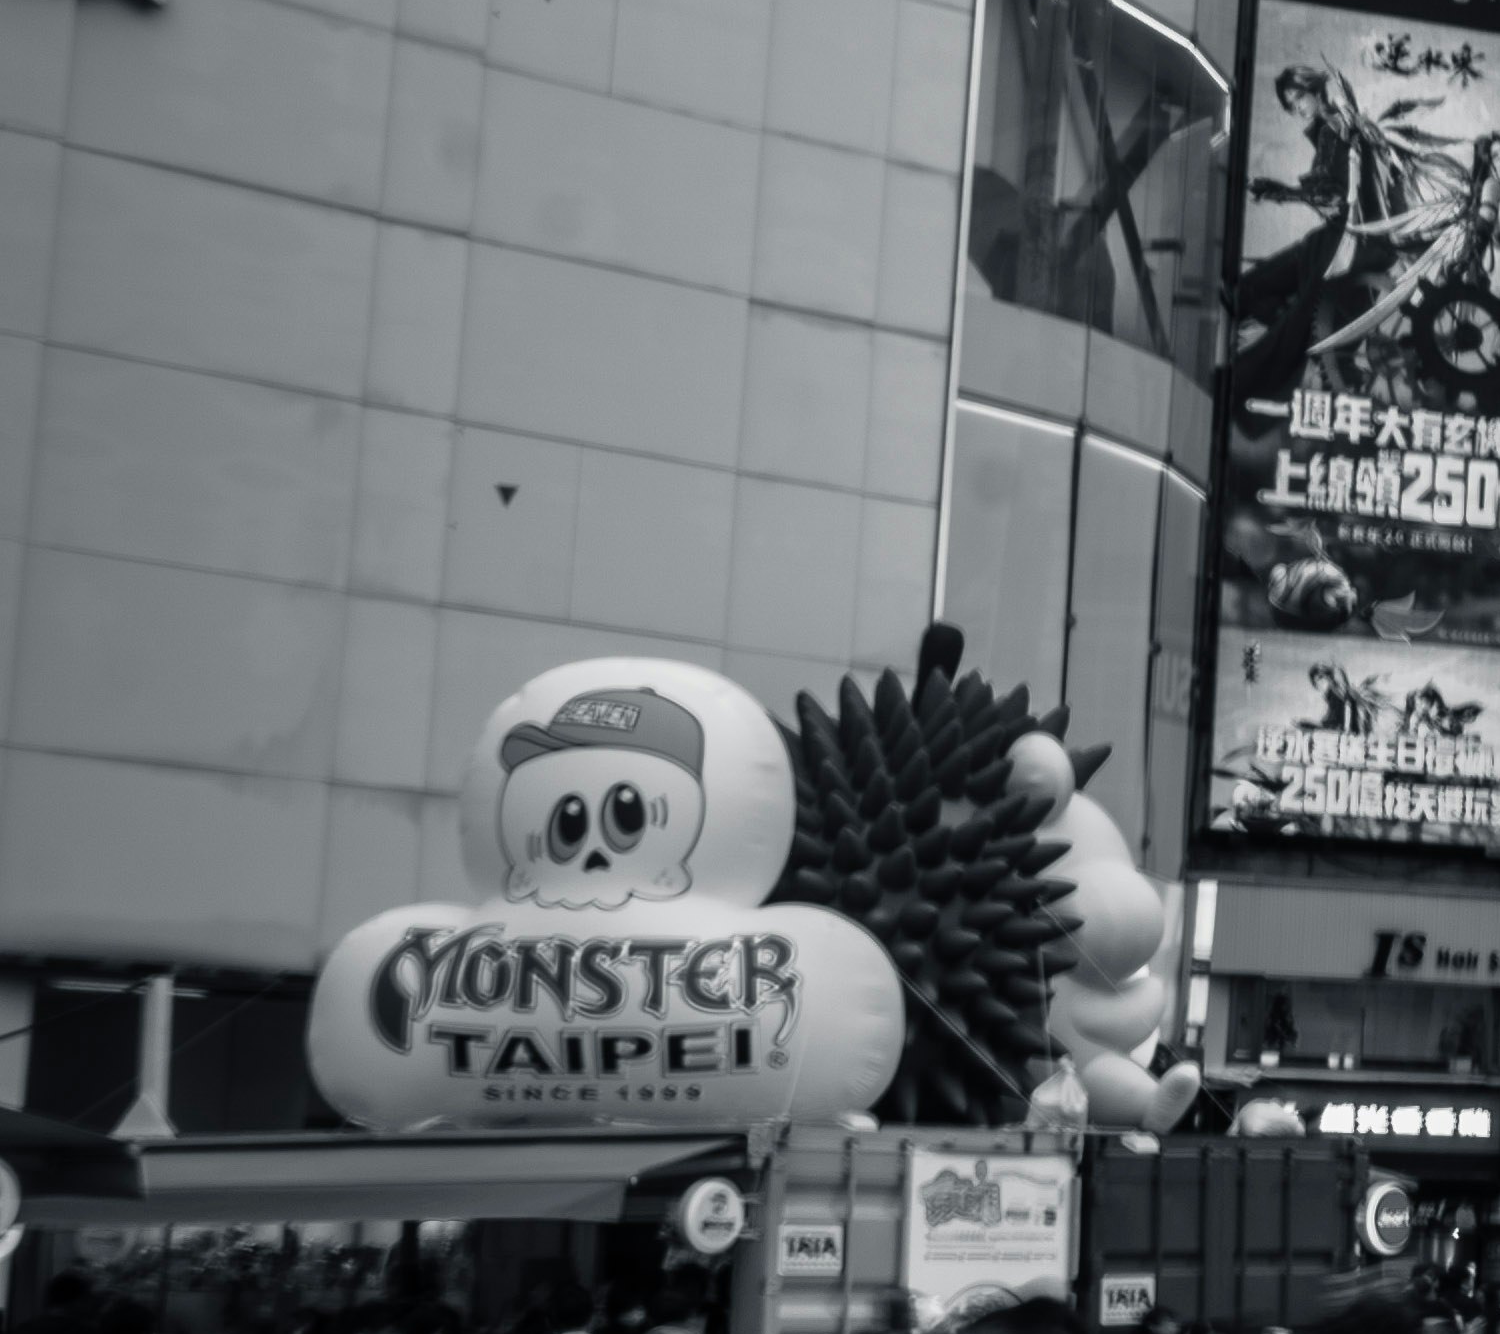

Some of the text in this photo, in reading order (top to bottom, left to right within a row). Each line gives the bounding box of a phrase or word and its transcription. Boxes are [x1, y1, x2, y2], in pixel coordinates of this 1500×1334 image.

[1436, 948, 1480, 972] Hair
[370, 924, 803, 1055] MONSTER
[427, 1019, 763, 1080] TAIPEI
[481, 1084, 704, 1103] SINCE 1999
